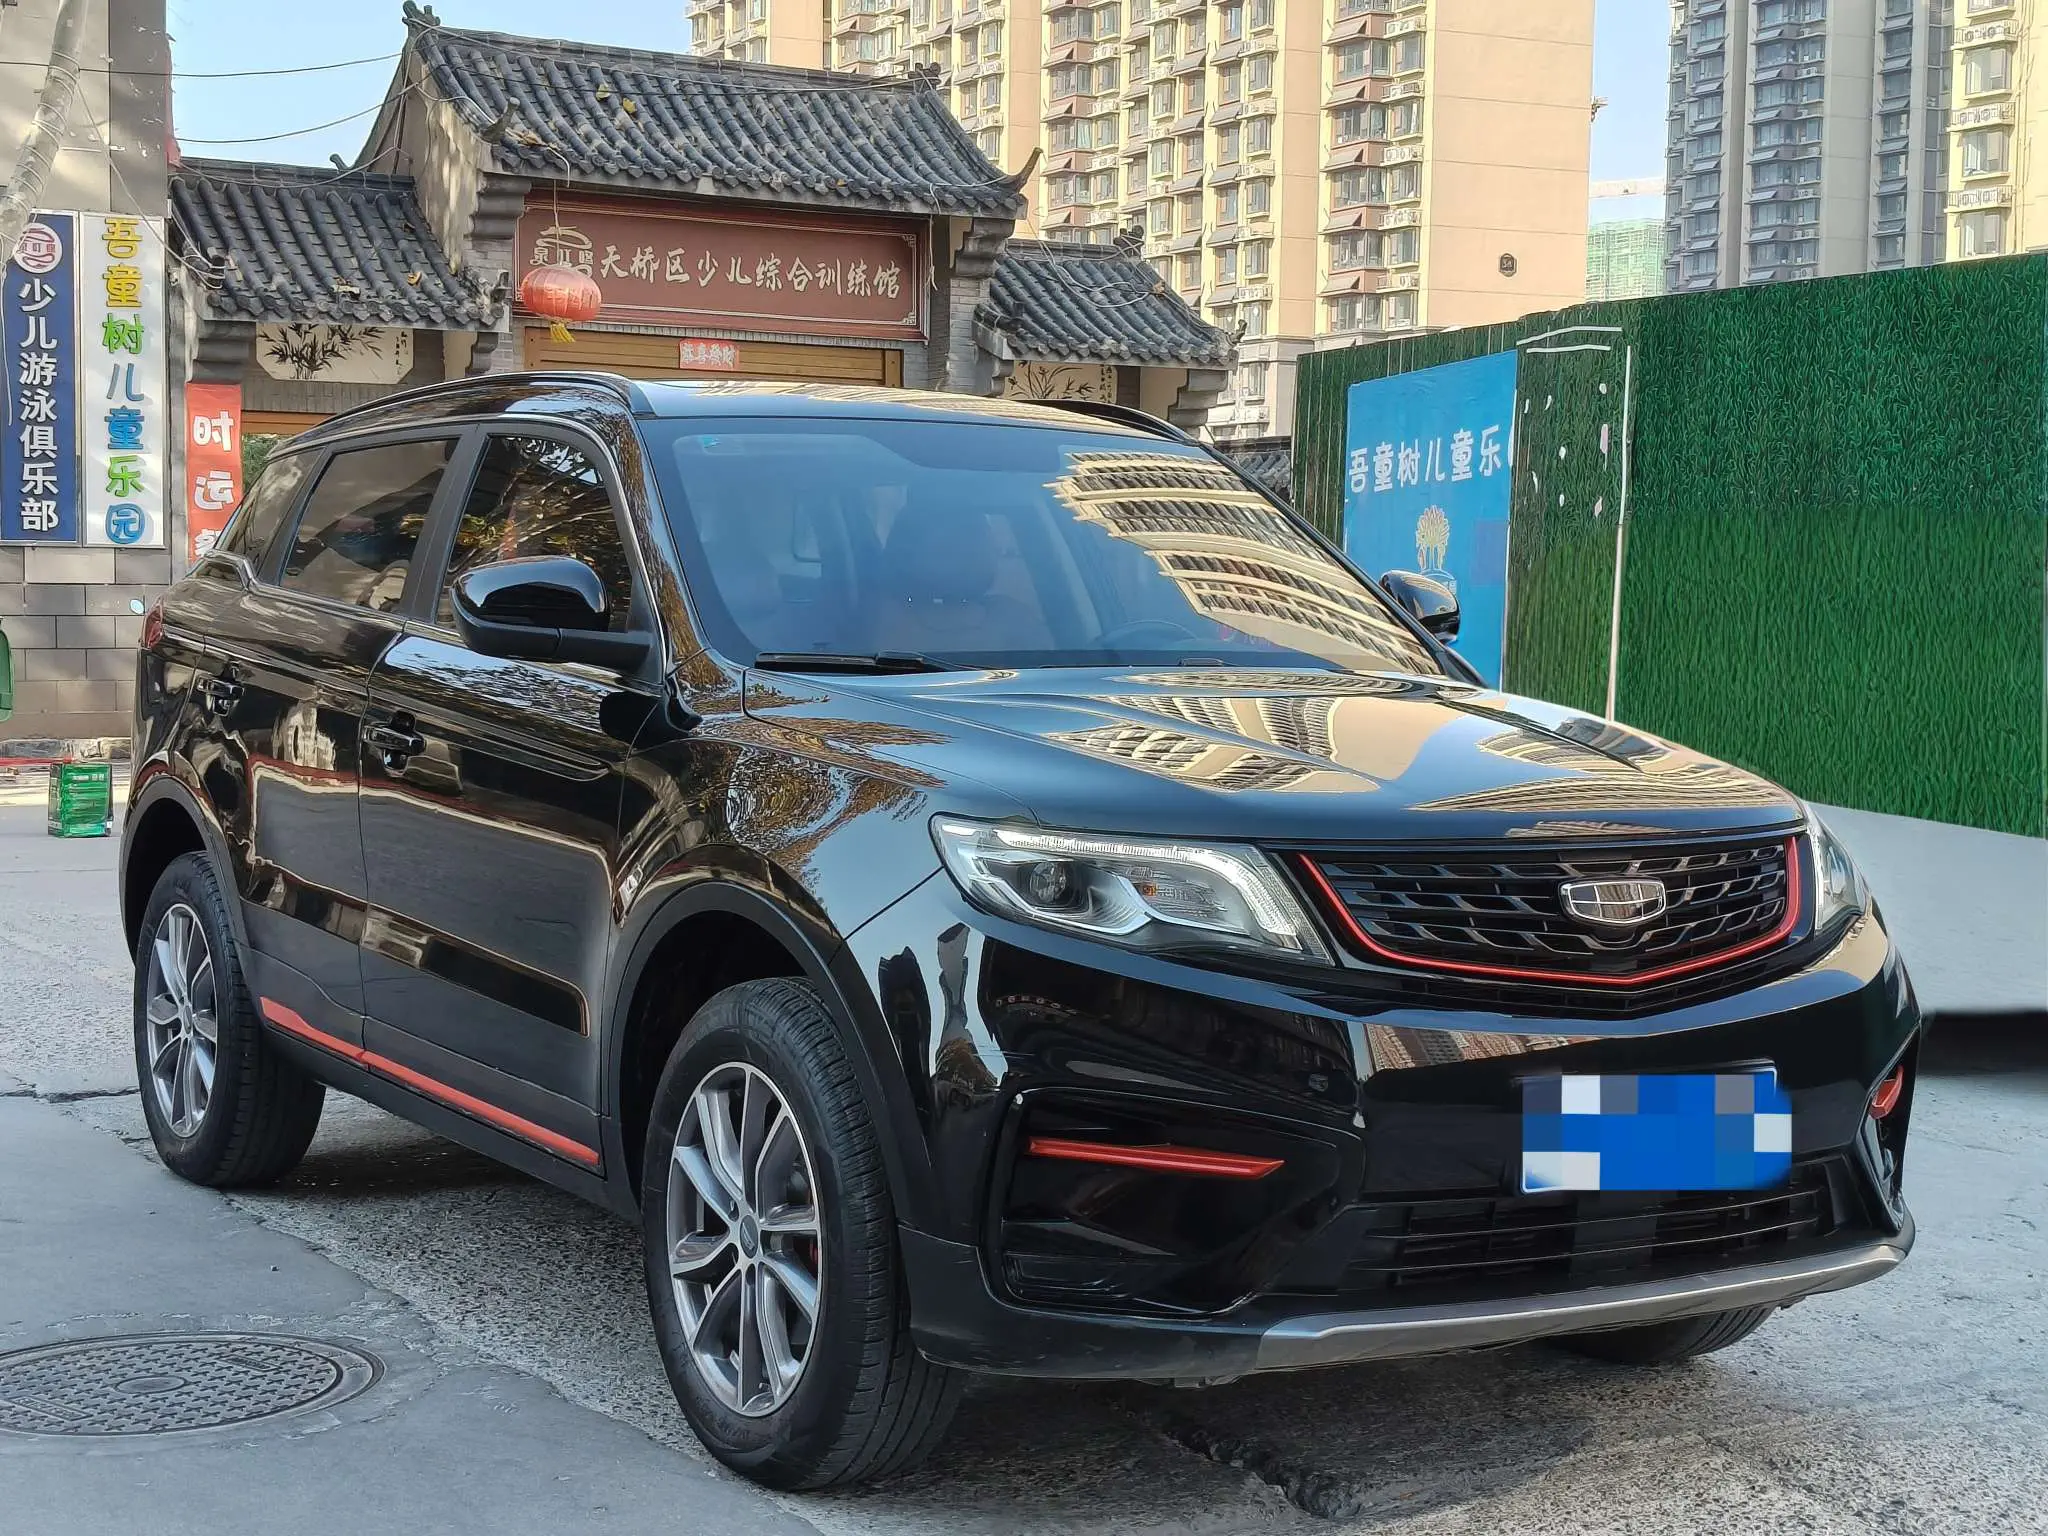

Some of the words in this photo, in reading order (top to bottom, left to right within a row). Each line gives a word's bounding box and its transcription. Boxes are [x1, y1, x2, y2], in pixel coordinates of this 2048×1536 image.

[600, 244, 901, 300] 天桥区少儿综合训练馆
[18, 277, 60, 532] 少儿游泳俱乐部
[102, 217, 146, 544] 吾童树儿童乐园
[1348, 423, 1515, 494] 吾童树儿童乐
